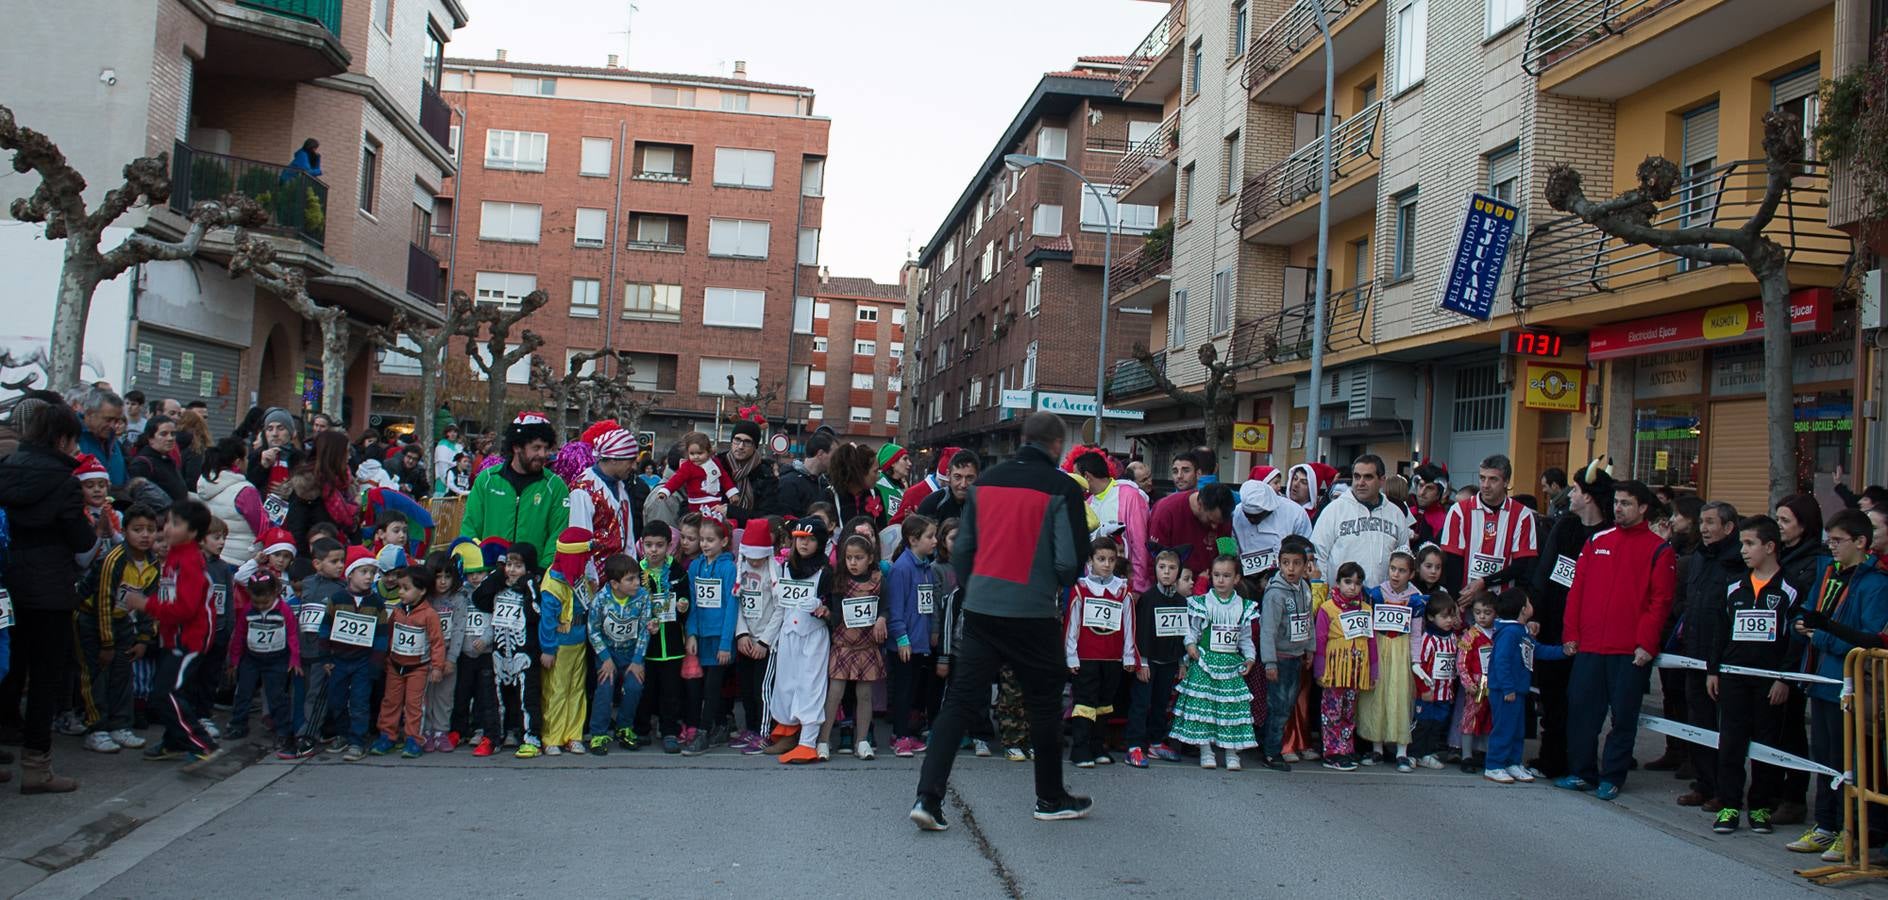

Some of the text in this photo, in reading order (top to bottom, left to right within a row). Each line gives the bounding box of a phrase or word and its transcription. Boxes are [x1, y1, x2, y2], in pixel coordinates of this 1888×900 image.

[1448, 214, 1480, 302] ELECTRICIDAD
[1463, 217, 1498, 303] EJUCAR
[1478, 224, 1510, 313] ILUMINACIÓN
[1789, 303, 1814, 318] Ejucar
[1658, 326, 1678, 338] Ejucar
[1808, 348, 1854, 368] SONIDO
[1649, 368, 1688, 386] ANTENAS
[1245, 554, 1269, 569] 397
[1474, 560, 1498, 574] 389
[783, 586, 809, 599] 264
[496, 604, 522, 620] 274
[854, 604, 872, 618] 54
[1094, 606, 1111, 620] 79
[1378, 611, 1404, 624] 209
[338, 619, 374, 636] 292
[1160, 614, 1183, 628] 271
[1739, 618, 1767, 632] 198
[609, 623, 633, 635] 128
[257, 631, 275, 644] 27
[398, 632, 416, 647] 94
[1216, 631, 1239, 644] 164
